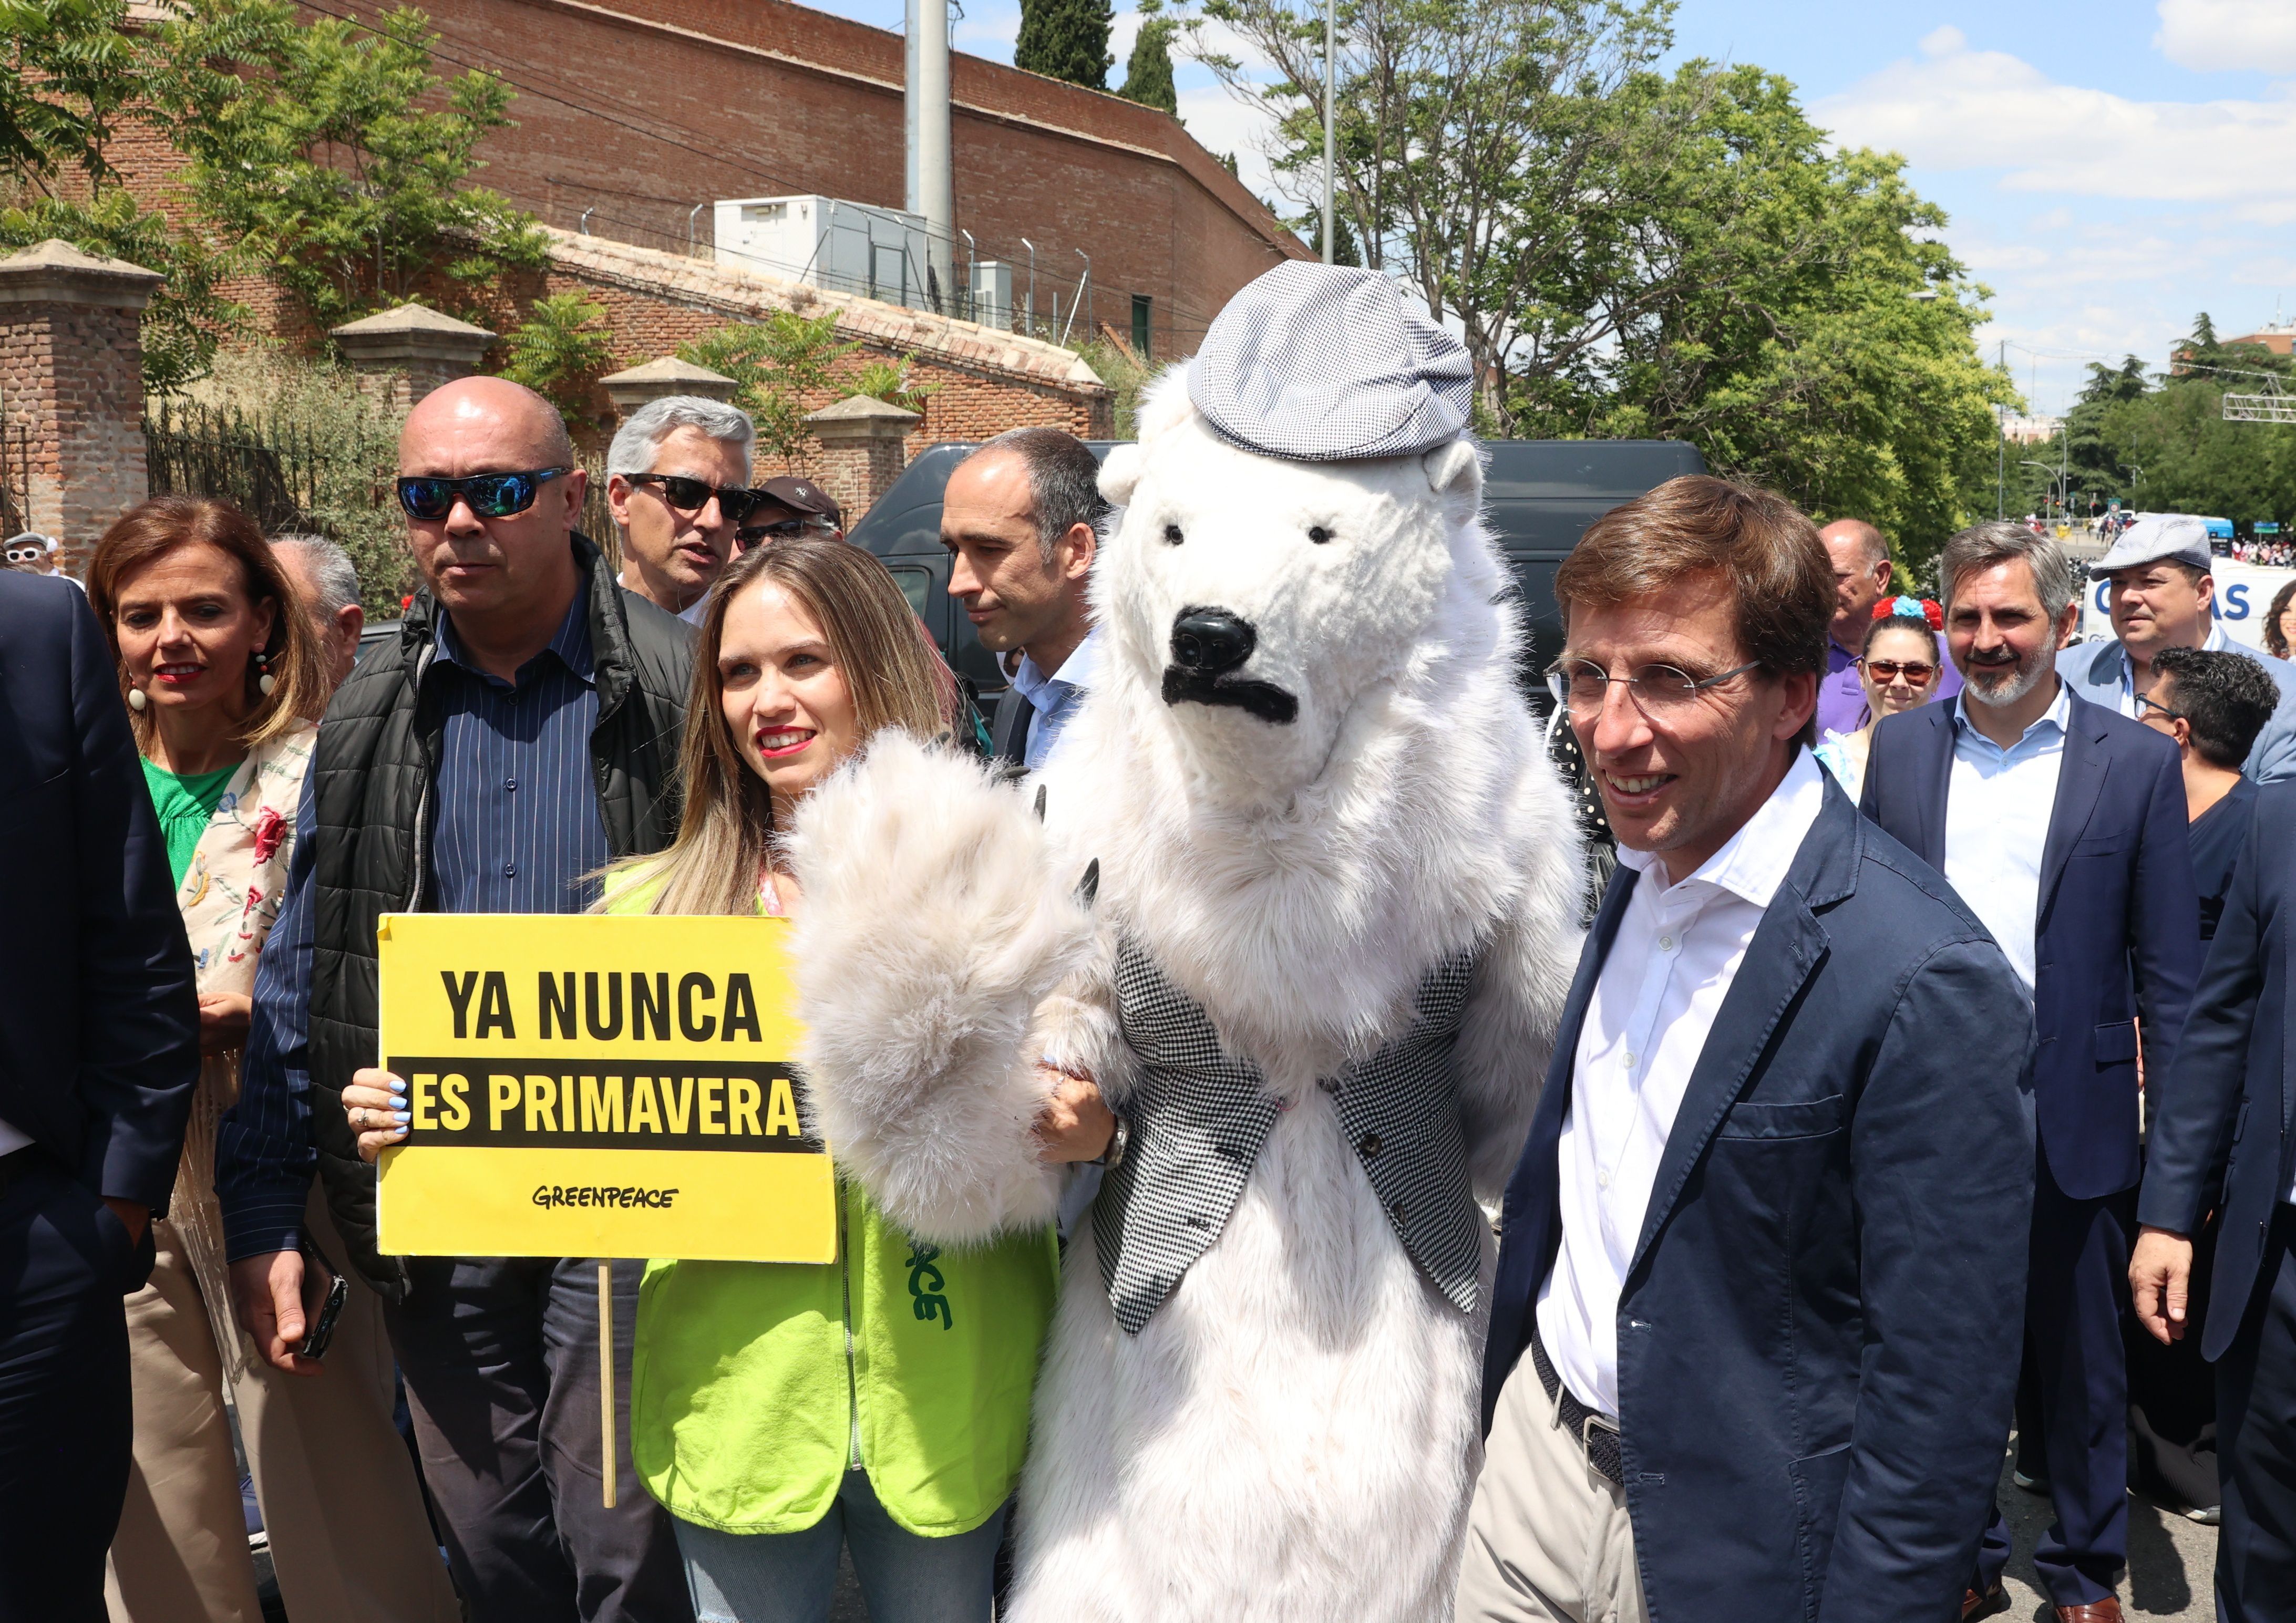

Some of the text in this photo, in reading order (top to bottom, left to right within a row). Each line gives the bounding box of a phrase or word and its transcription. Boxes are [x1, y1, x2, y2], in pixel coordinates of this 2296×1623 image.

[440, 971, 763, 1042] YA NUNCA
[413, 1073, 802, 1136] ES PRIMAVERA
[532, 1185, 679, 1210] GREENPEACE
